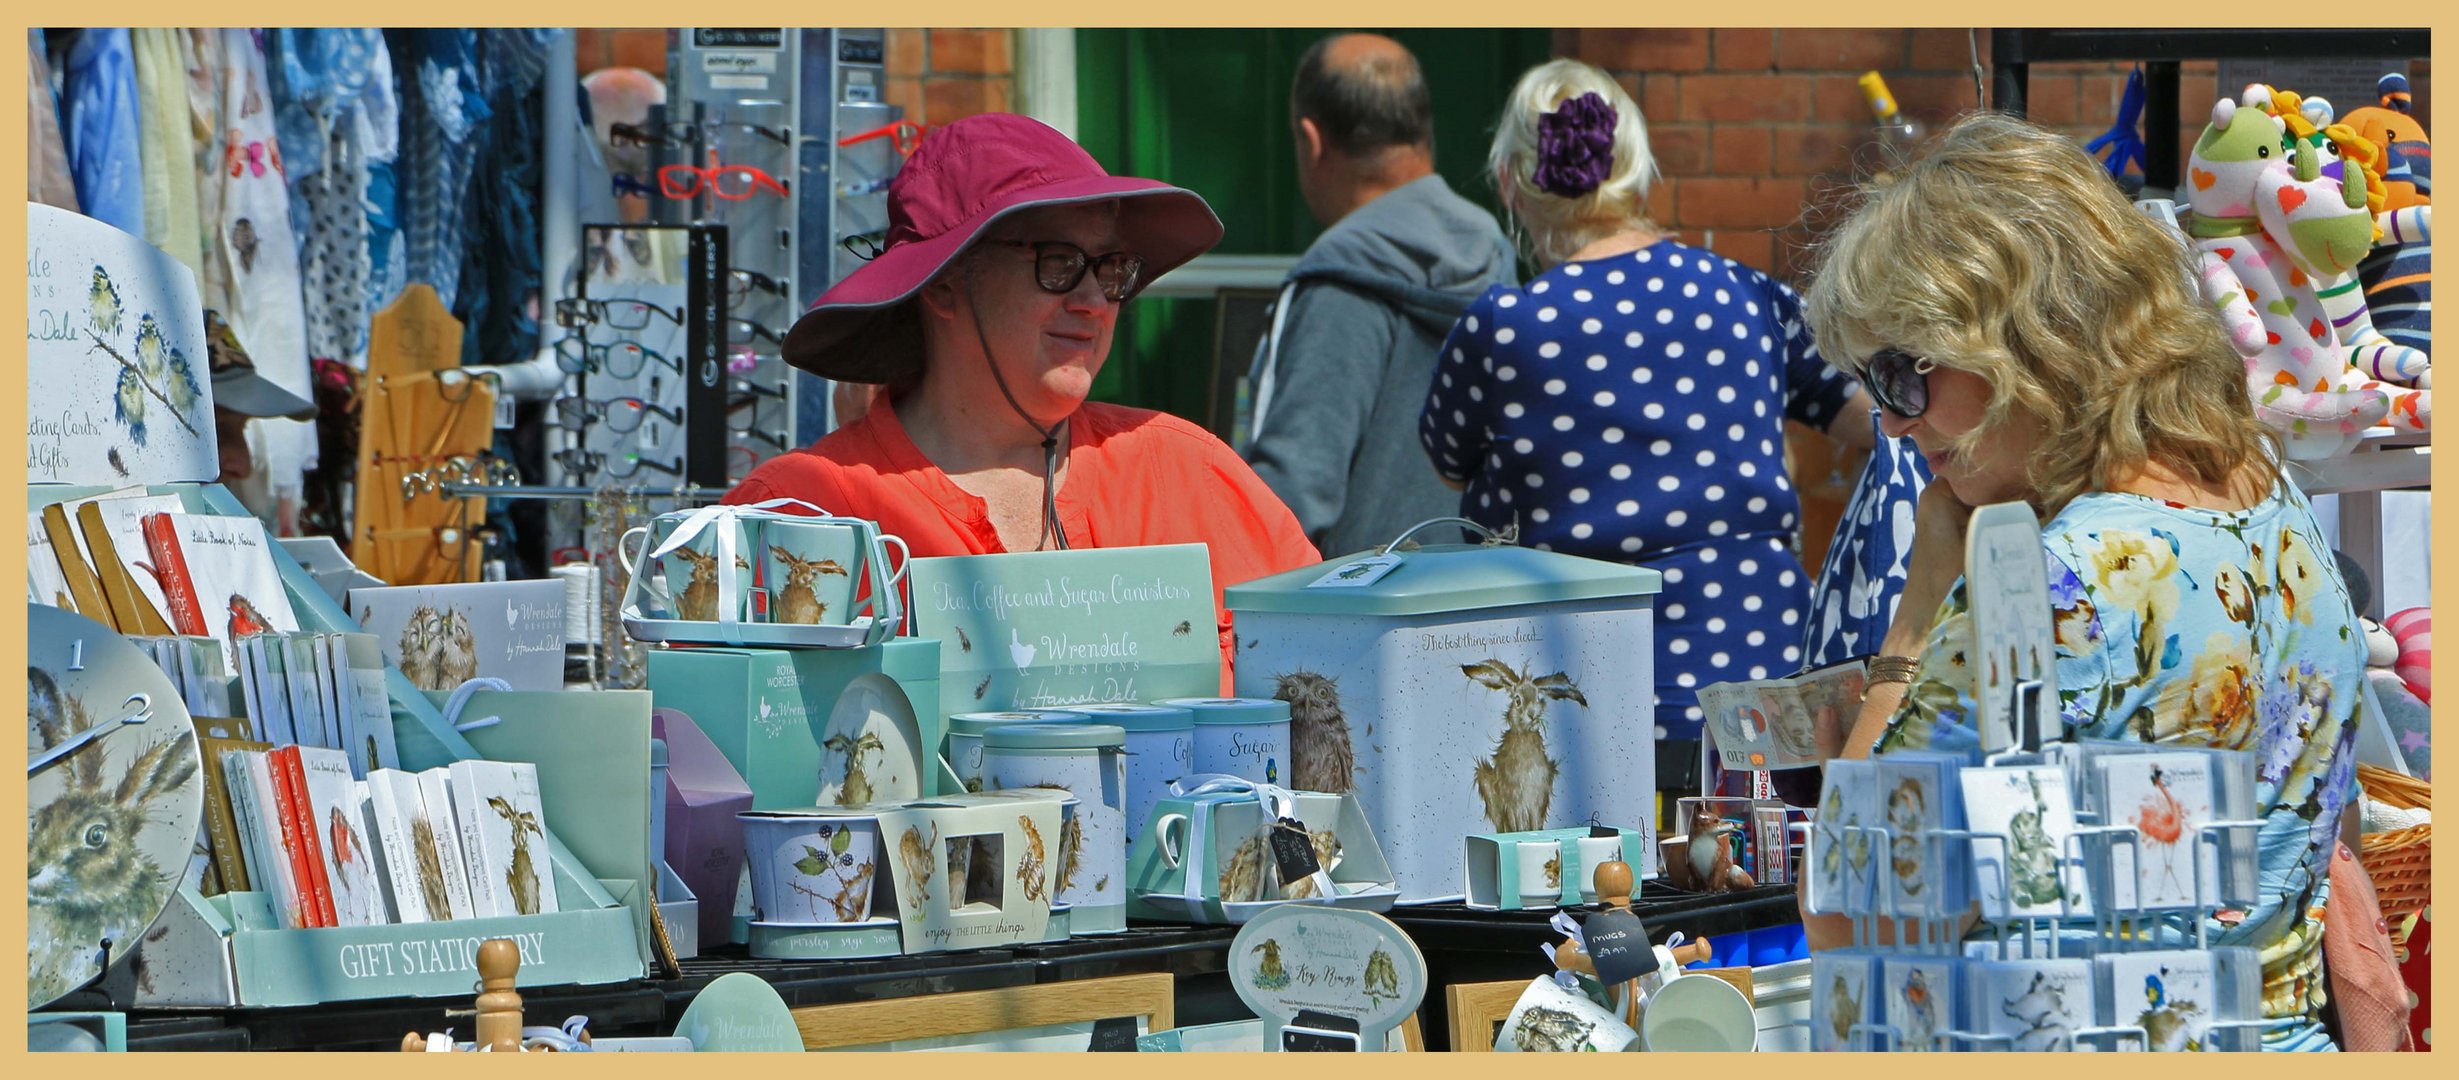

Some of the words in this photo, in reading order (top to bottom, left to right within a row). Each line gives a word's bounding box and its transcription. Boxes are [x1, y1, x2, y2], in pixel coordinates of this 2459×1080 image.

[40, 309, 79, 341] Dale
[40, 442, 69, 480] Gifts
[209, 530, 227, 545] Book
[228, 533, 237, 551] of
[973, 580, 1021, 622] Coffee
[1024, 579, 1055, 607] and
[1060, 576, 1107, 617] Sugar
[1111, 573, 1190, 605] Canisters
[520, 601, 562, 621] Wrendale
[67, 639, 85, 671] 1
[506, 640, 514, 662] by
[1040, 631, 1138, 660] Wrendale
[1444, 634, 1461, 651] best
[1461, 632, 1488, 653] thing
[1488, 632, 1510, 645] since
[1054, 660, 1141, 676] DESIGNS
[1030, 678, 1099, 708] Hannah
[1100, 677, 1138, 703] Dale
[121, 692, 154, 725] 2
[1229, 731, 1277, 764] Sugar
[1726, 749, 1745, 765] £10
[1765, 825, 1781, 847] THE
[789, 934, 830, 951] parsley
[840, 937, 865, 950] sage
[924, 926, 952, 944] enjoy
[956, 926, 969, 937] THE
[969, 924, 992, 936] LITTLE
[995, 918, 1025, 939] things
[340, 942, 395, 979] GIFT
[400, 932, 545, 975] STATIORY
[1295, 962, 1321, 987] Key
[1322, 964, 1356, 988] Rings
[713, 1014, 784, 1040] Wrendale
